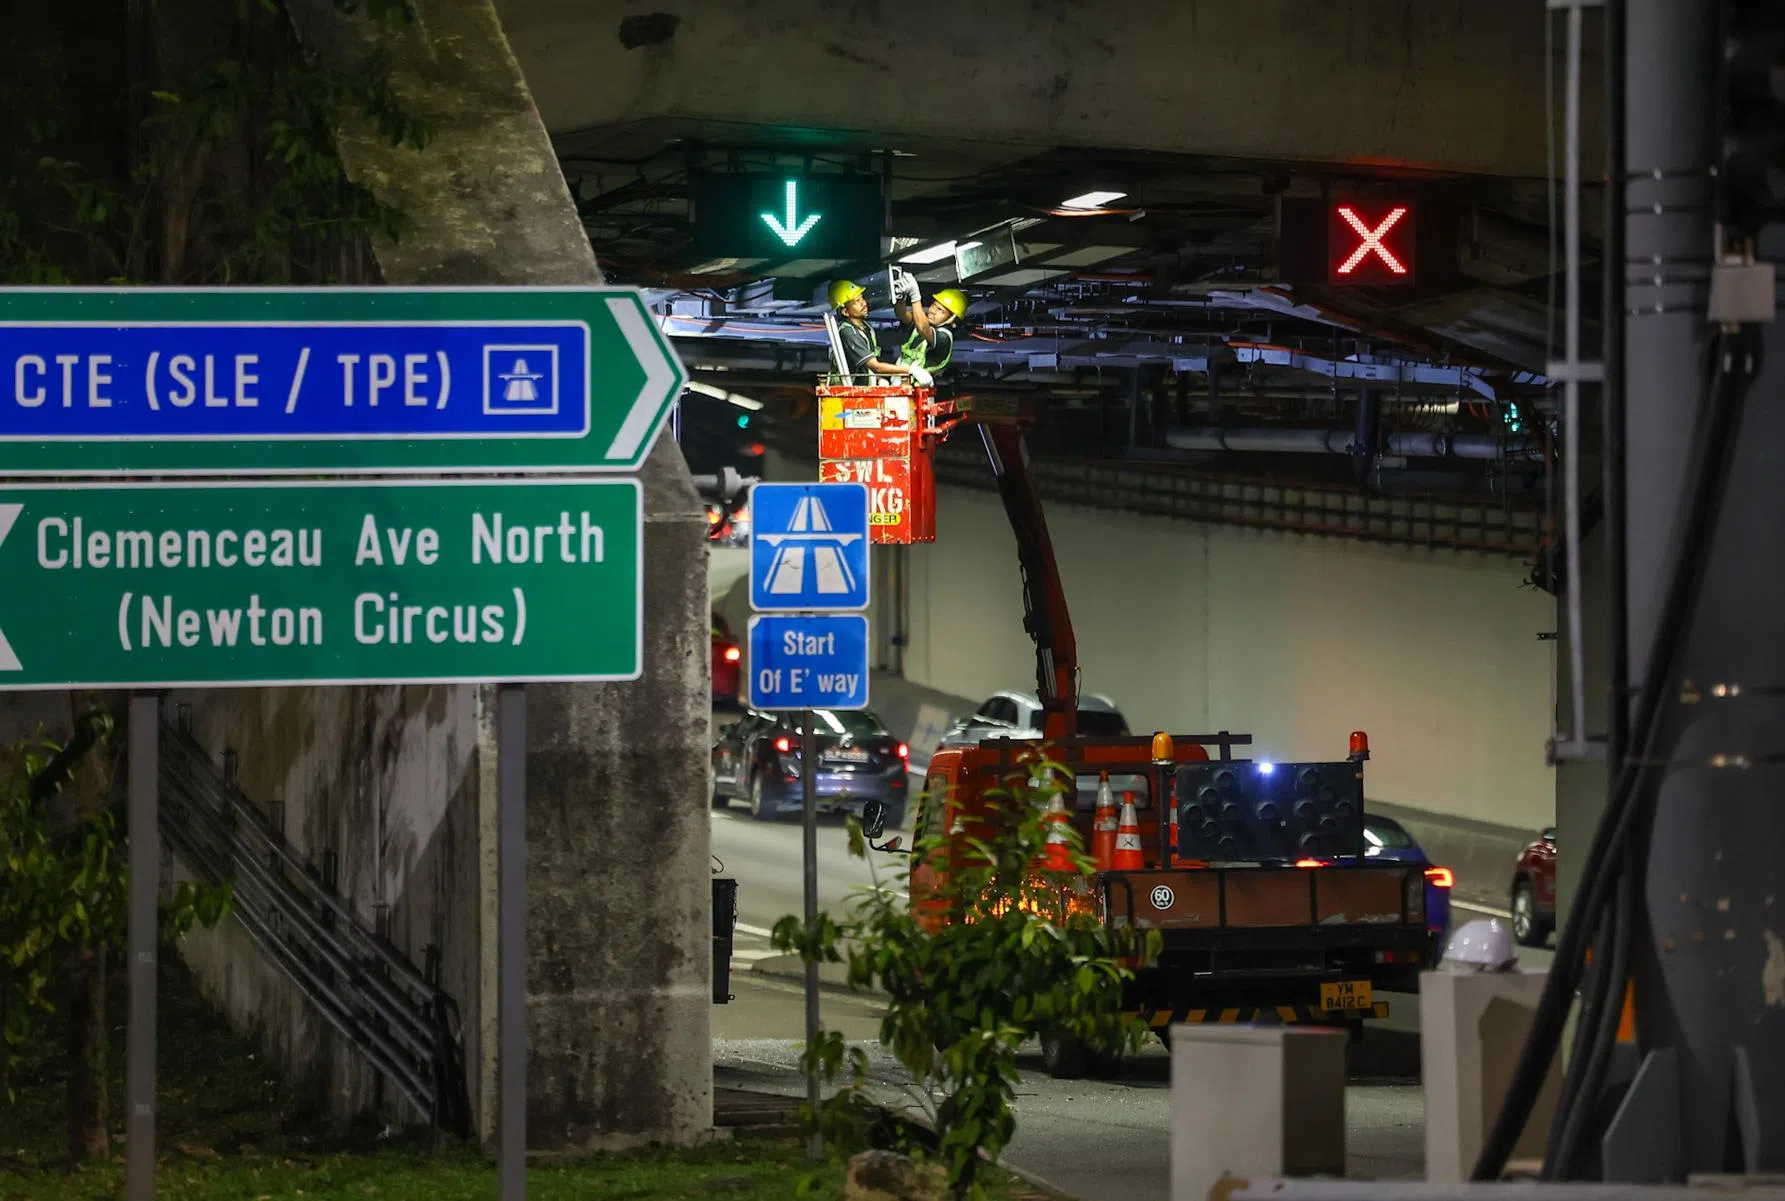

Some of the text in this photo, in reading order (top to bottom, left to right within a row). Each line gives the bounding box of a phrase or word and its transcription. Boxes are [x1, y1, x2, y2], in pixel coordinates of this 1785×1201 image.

[15, 347, 451, 414] CTE (SLE / TPE)
[835, 461, 893, 483] SWL
[37, 512, 604, 569] Clemenceau Ave North
[118, 587, 526, 651] (Newton Circus)
[783, 631, 835, 656] Start
[760, 668, 782, 694] Of
[1154, 888, 1170, 902] 60
